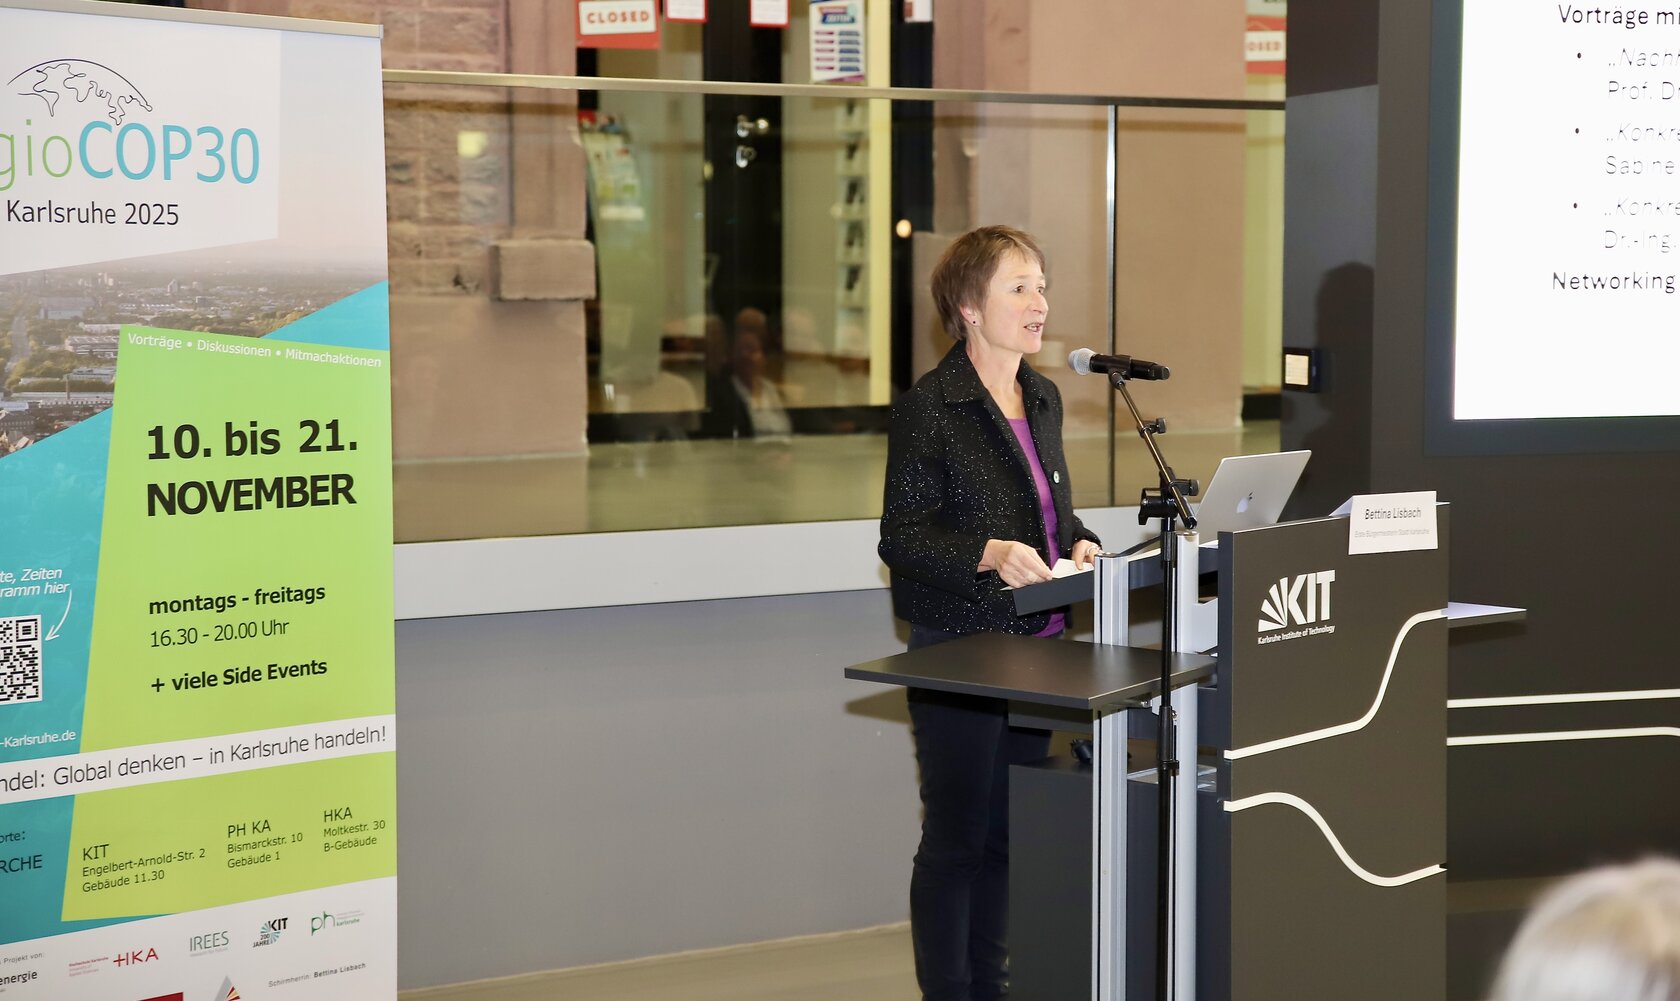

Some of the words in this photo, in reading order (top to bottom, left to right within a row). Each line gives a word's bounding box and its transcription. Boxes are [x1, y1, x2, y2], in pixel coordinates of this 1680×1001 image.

[587, 10, 649, 24] CLOSED
[1558, 4, 1649, 29] Vorträge
[1605, 155, 1675, 175] Sabine
[7, 199, 116, 224] Karlsruhe
[124, 202, 179, 225] 2025
[1552, 271, 1676, 294] Networking
[127, 332, 182, 350] Vorträge
[197, 339, 272, 357] Diskussionen
[285, 348, 382, 367] Mitmachaktionen
[147, 424, 211, 459] 10.
[225, 420, 281, 457] bis
[299, 419, 357, 453] 21.
[147, 473, 357, 517] NOVEMBER
[1365, 508, 1391, 520] Bettina
[1393, 507, 1421, 519] Lisbach
[21, 567, 63, 582] Zeiten
[44, 582, 70, 595] hier
[1280, 569, 1336, 625] KIT
[149, 595, 237, 615] montags
[254, 586, 326, 605] freitags
[150, 627, 198, 648] 16.30
[214, 621, 258, 642] 20.00
[261, 619, 290, 637] Uhr
[1257, 634, 1281, 645] Karlsruhe
[1281, 630, 1302, 641] Institute
[1302, 627, 1309, 637] of
[1309, 624, 1336, 636] Technology
[172, 671, 218, 691] viele
[223, 666, 263, 686] Side
[267, 660, 327, 680] Events
[53, 760, 112, 786] Global
[117, 754, 186, 777] denken
[209, 747, 224, 764] in
[230, 737, 309, 762] Karlsruhe
[315, 725, 386, 750] handeln!
[323, 806, 353, 823] HKA
[227, 823, 246, 838] PH
[252, 819, 272, 835] KA
[323, 823, 369, 838] Moltkestr.
[373, 819, 386, 831] 30
[82, 843, 110, 861] KIT
[227, 836, 287, 853] Bismarckstr.
[291, 832, 303, 843] 10
[323, 836, 377, 852] B-Gebäude
[82, 850, 195, 878] Engelbert-Arnold-Str.
[199, 848, 206, 859] 2
[227, 853, 272, 869] Gebäude
[275, 851, 281, 861] 1
[82, 876, 130, 893] Gebäude
[134, 869, 165, 884] 11.30
[268, 917, 288, 931] KIT
[311, 911, 335, 936] ph
[189, 931, 229, 952] IREES
[3, 954, 28, 964] Projekt
[313, 968, 338, 978] Bettina
[340, 962, 366, 973] Lisbach
